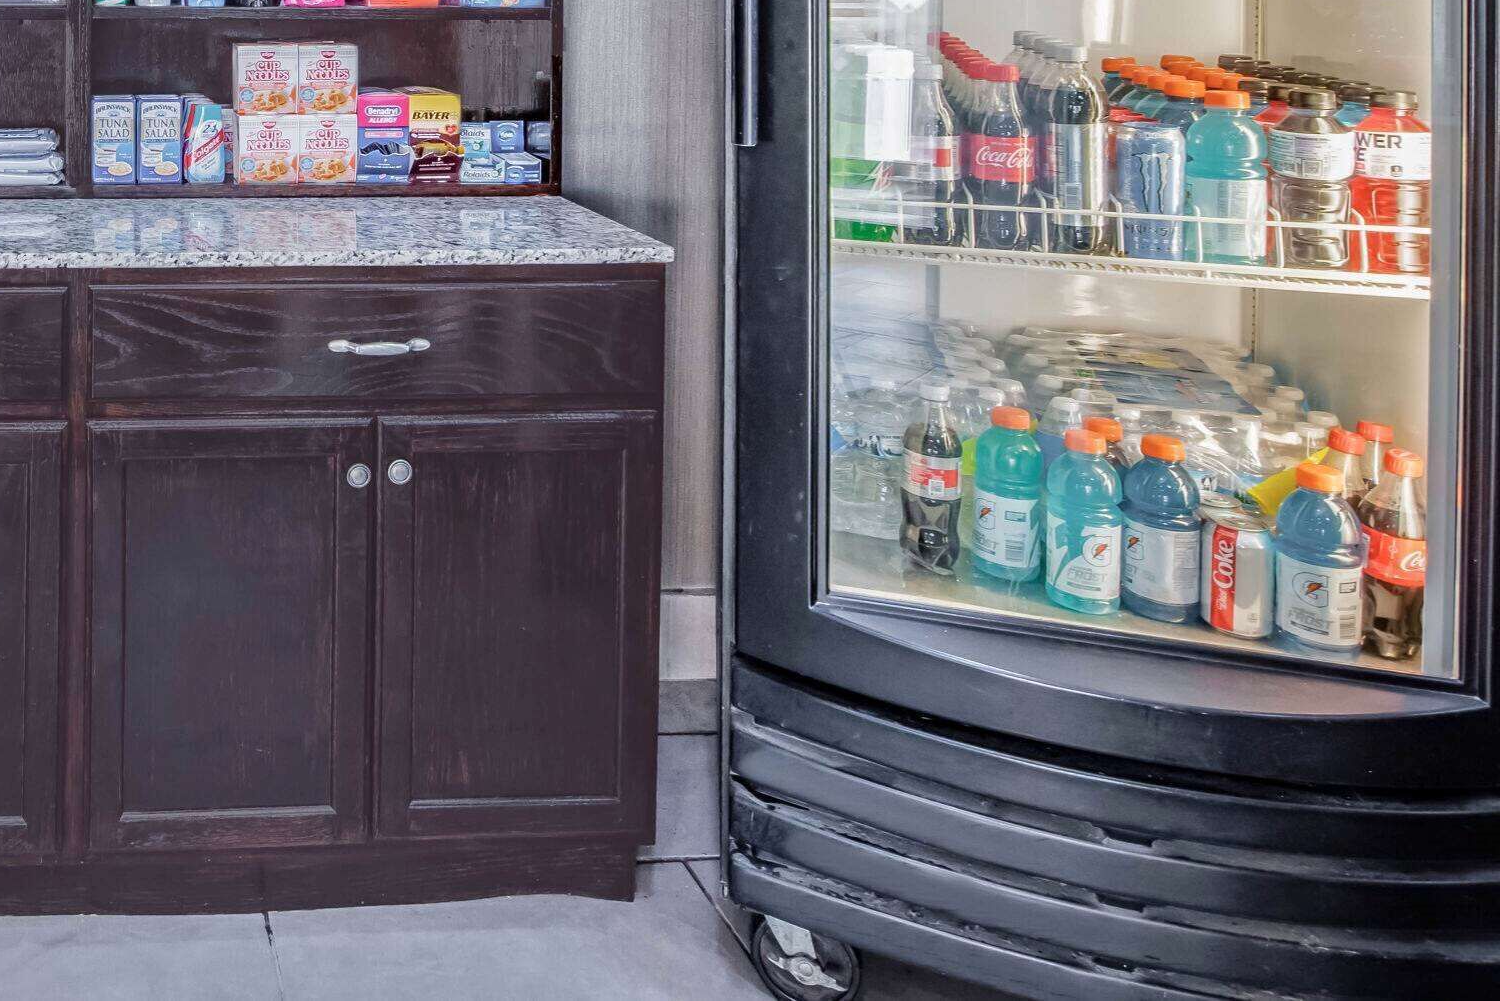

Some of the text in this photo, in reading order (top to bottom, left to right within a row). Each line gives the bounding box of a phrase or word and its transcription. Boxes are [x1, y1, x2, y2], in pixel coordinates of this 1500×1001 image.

[256, 60, 282, 71] CUP
[317, 60, 342, 71] CUP
[245, 69, 290, 82] NOODLES
[305, 69, 349, 81] NOODLES
[94, 102, 131, 115] BRUNSWICK
[142, 102, 178, 115] BRUNSWICK
[367, 105, 400, 117] Benadryl
[411, 111, 451, 121] BAYER
[101, 118, 129, 129] TUNA
[146, 118, 175, 129] TUNA
[98, 129, 130, 138] SALAD
[143, 129, 177, 138] SALAD
[257, 128, 283, 140] CUP
[318, 128, 341, 140] CUP
[460, 129, 485, 139] olaids
[246, 138, 292, 151] NOODLES
[305, 138, 349, 150] NOODLES
[975, 144, 1033, 169] Coca-Cola
[463, 171, 492, 180] Rolaids
[1213, 539, 1234, 589] Coke
[1067, 566, 1108, 582] FROST
